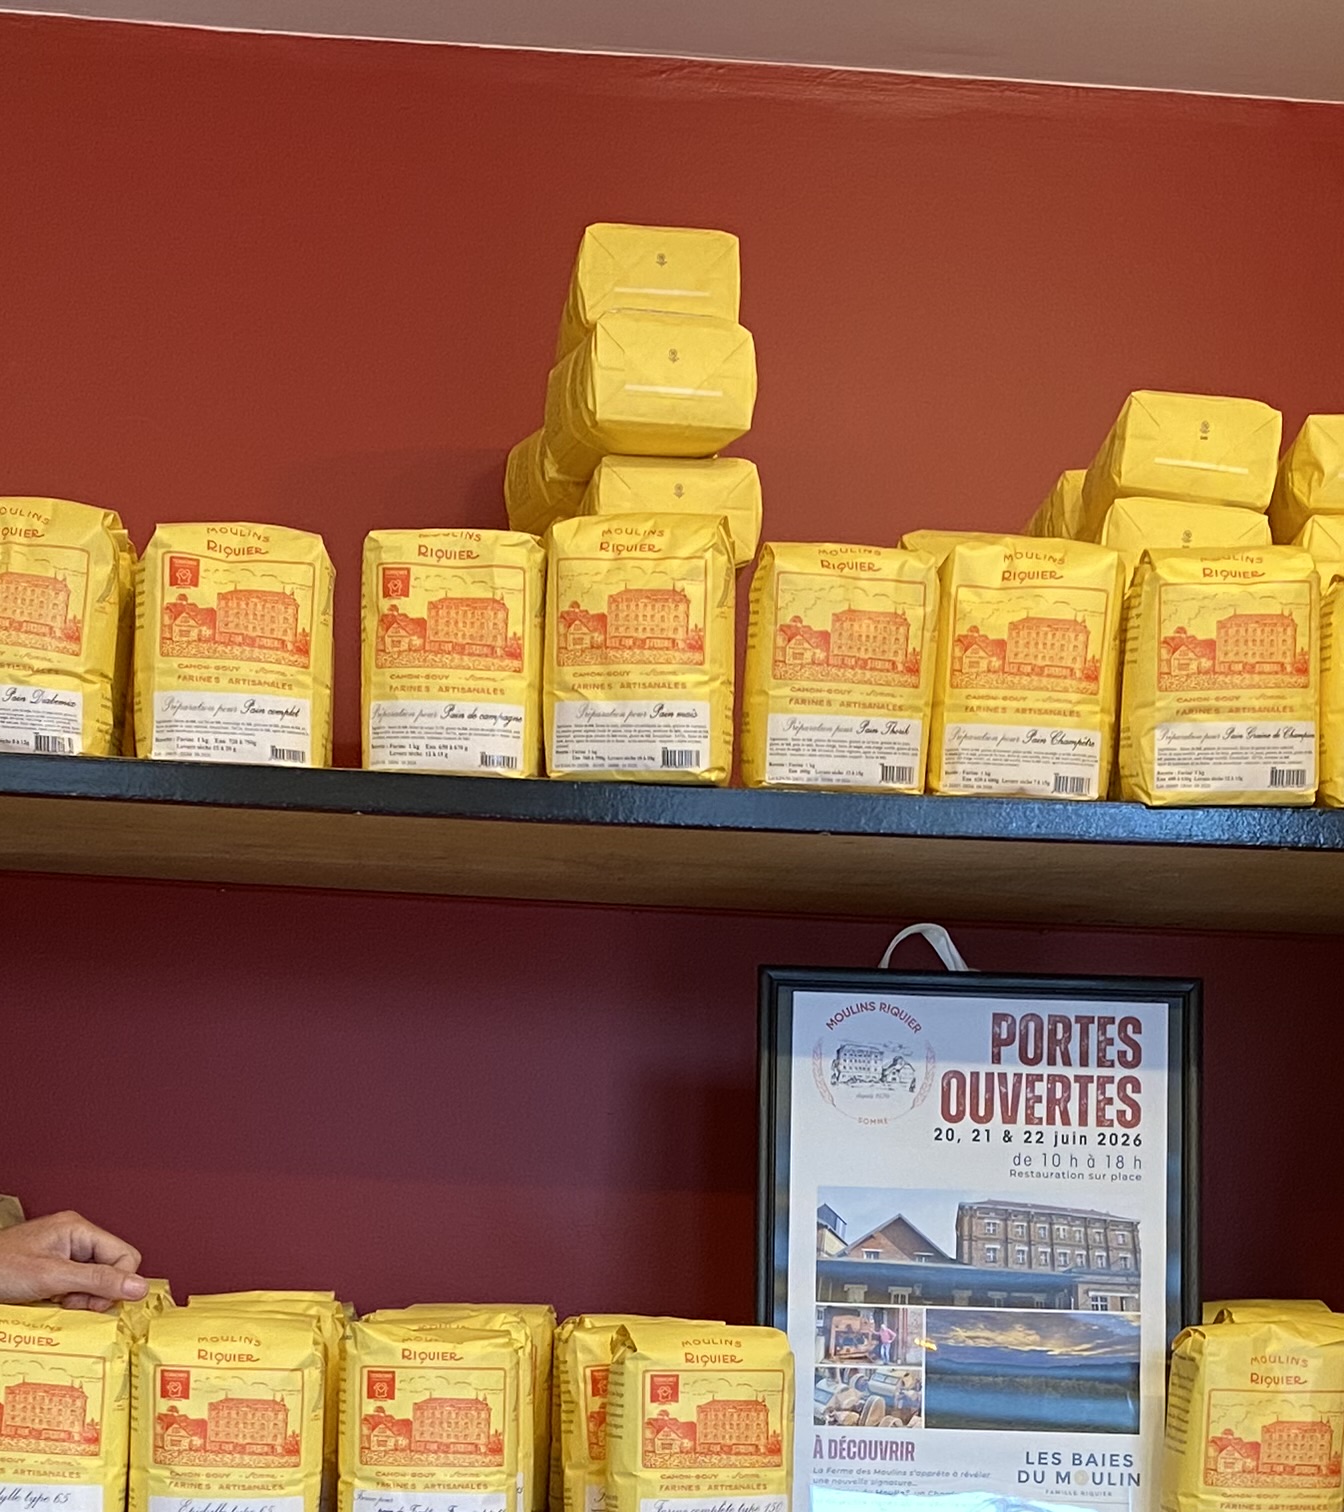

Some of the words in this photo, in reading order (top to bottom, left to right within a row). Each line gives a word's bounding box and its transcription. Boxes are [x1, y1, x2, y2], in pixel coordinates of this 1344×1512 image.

[207, 527, 270, 544] MOULINS
[601, 528, 665, 538] MOULINS
[207, 540, 269, 559] RIQUIER
[418, 544, 480, 563] RIQUIER
[599, 541, 662, 556] RIQUIER
[818, 546, 882, 557] MOULINS
[1003, 551, 1065, 565] MOULINS
[820, 559, 882, 573] RIQUIER
[1001, 570, 1064, 585] RIQUIER
[1202, 567, 1266, 581] RIQUIER
[228, 677, 293, 691] ARTISANALES
[438, 686, 505, 696] ARTISANALES
[619, 682, 687, 690] ARTISANALES
[789, 698, 832, 708] FARINES
[839, 698, 904, 712] ARTISANALES
[826, 1001, 876, 1031] MOULINS
[879, 1002, 922, 1034] RIQUIER
[991, 1012, 1143, 1069] PORTES
[940, 1069, 1142, 1129] OUVERTES
[934, 1127, 961, 1144] 20,
[972, 1129, 991, 1143] 21
[1002, 1130, 1013, 1143] &
[1023, 1130, 1044, 1144] 22
[1054, 1132, 1088, 1147] juin
[1097, 1132, 1142, 1147] 2026
[1013, 1153, 1032, 1167] de
[1042, 1153, 1061, 1168] 10
[1070, 1155, 1078, 1168] h
[1087, 1154, 1095, 1169] à
[1106, 1155, 1125, 1169] 18
[1134, 1156, 1142, 1169] h
[1010, 1169, 1084, 1180] Restauration
[1089, 1172, 1106, 1181] sur
[1111, 1172, 1142, 1182] place
[197, 1335, 262, 1348] MOULINS
[682, 1338, 742, 1349] MOULINS
[197, 1348, 260, 1365] RIQUIER
[401, 1348, 464, 1365] RIQUIER
[684, 1352, 743, 1367] RIQUIER
[1250, 1355, 1309, 1369] MOULINS
[1250, 1372, 1308, 1389] RIQUIER
[813, 1434, 823, 1460] À
[828, 1436, 915, 1462] DÉCOUVRIR
[1025, 1451, 1062, 1466] LES
[1072, 1453, 1134, 1468] BAIES
[12, 1467, 81, 1480] ARTISANALES
[813, 1467, 824, 1475] La
[856, 1468, 871, 1476] des
[873, 1469, 908, 1477] Moulins
[1018, 1470, 1045, 1484] DU
[218, 1482, 285, 1492] ARTISANALES
[423, 1482, 488, 1491] ARTISANALES
[659, 1484, 701, 1492] FARINES
[707, 1483, 767, 1492] ARTISANALES
[20, 1490, 49, 1509] type
